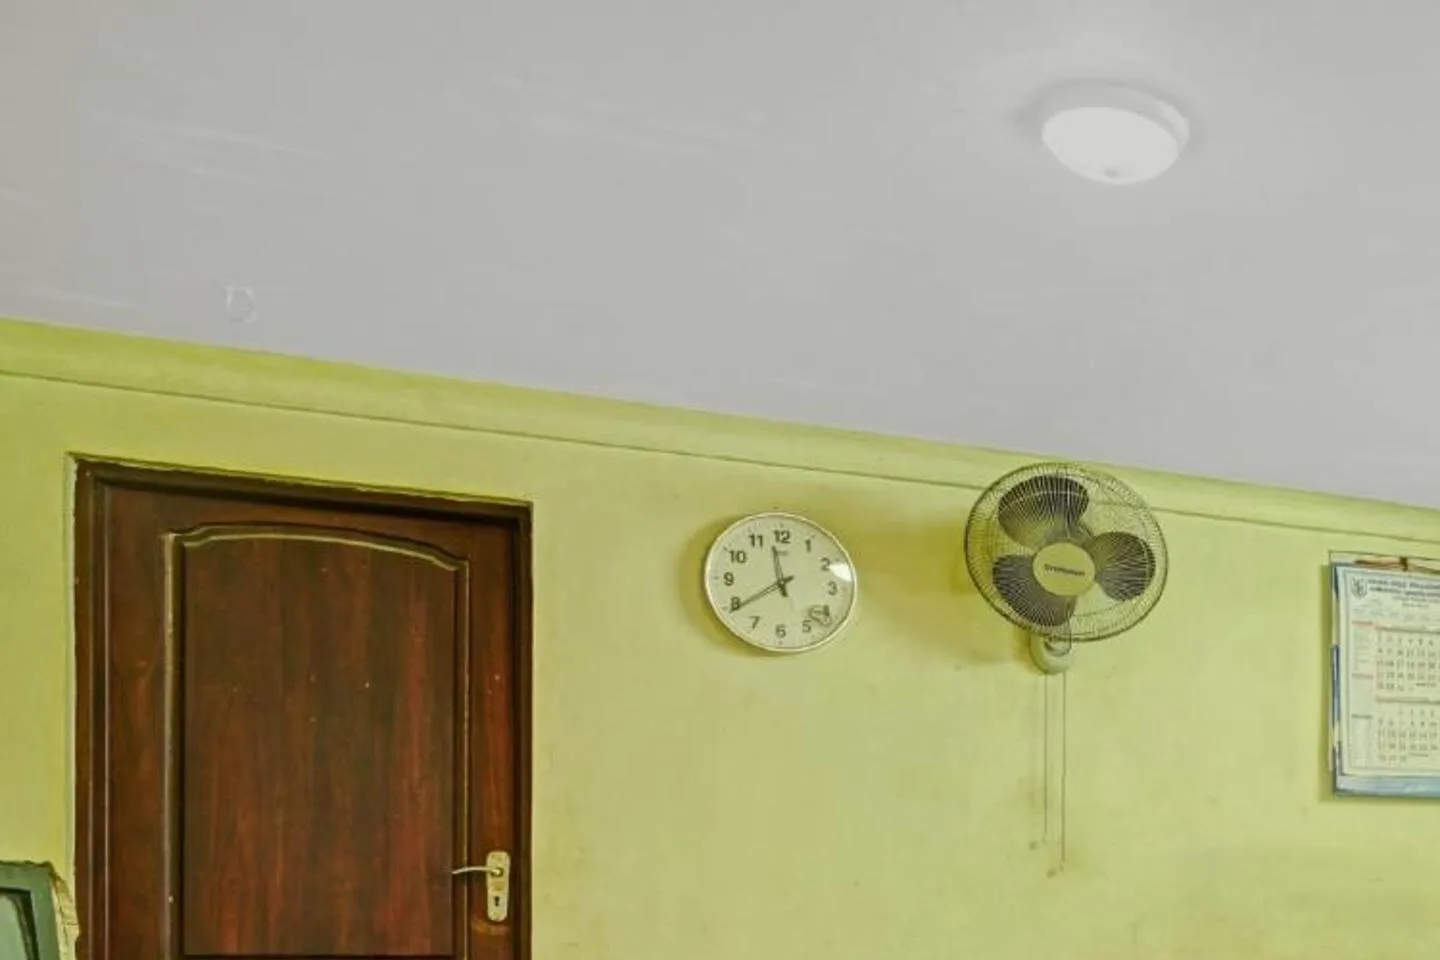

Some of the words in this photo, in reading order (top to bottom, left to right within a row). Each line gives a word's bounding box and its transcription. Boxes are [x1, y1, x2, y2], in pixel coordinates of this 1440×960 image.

[749, 534, 764, 547] 11
[773, 529, 791, 543] 12
[805, 539, 811, 553] 1
[730, 550, 747, 563] 10
[820, 557, 831, 571] 2
[723, 572, 734, 586] 9
[828, 581, 837, 595] 3
[749, 616, 760, 629] 7
[802, 619, 812, 633] 5
[775, 624, 786, 638] 6
